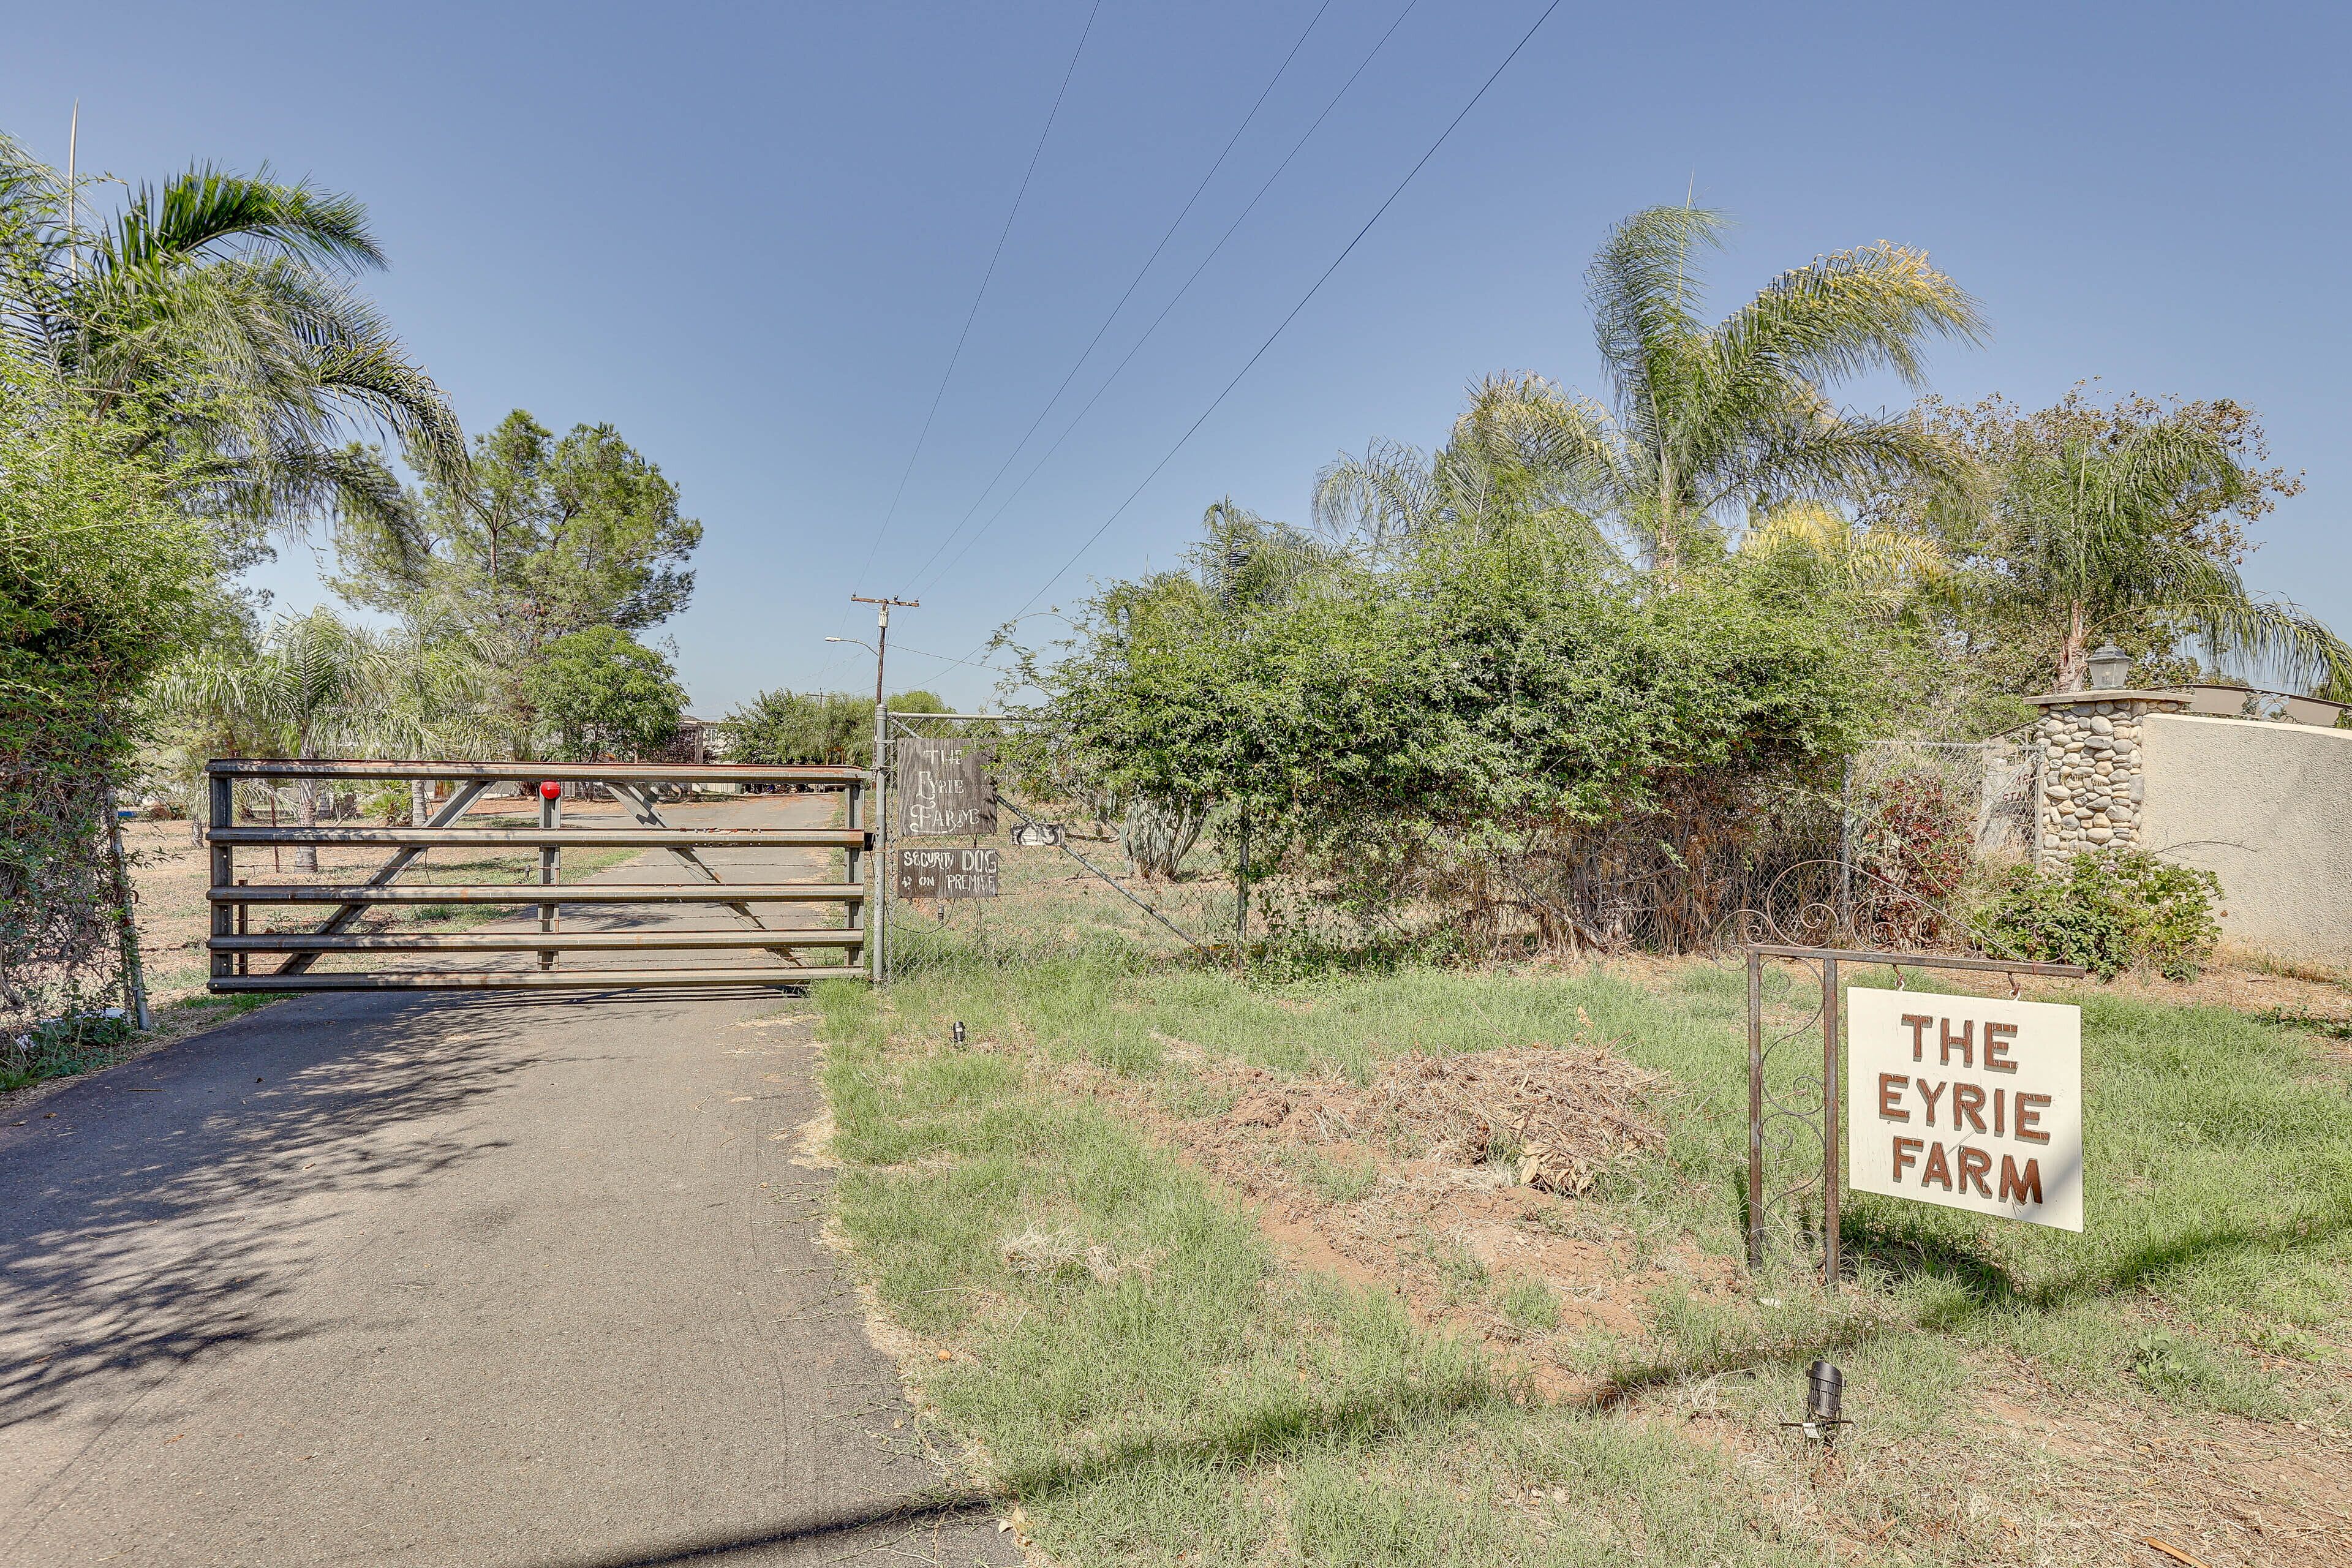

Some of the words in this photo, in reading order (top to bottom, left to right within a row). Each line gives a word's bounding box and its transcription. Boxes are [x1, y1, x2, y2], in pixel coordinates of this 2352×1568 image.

[923, 750, 963, 765] THE
[903, 851, 955, 870] SECURITY
[962, 850, 997, 873] DOG
[919, 876, 935, 887] ON
[1901, 1013, 2019, 1074] THE
[1879, 1072, 2052, 1145] EYRIE
[1893, 1135, 2043, 1206] FARM
